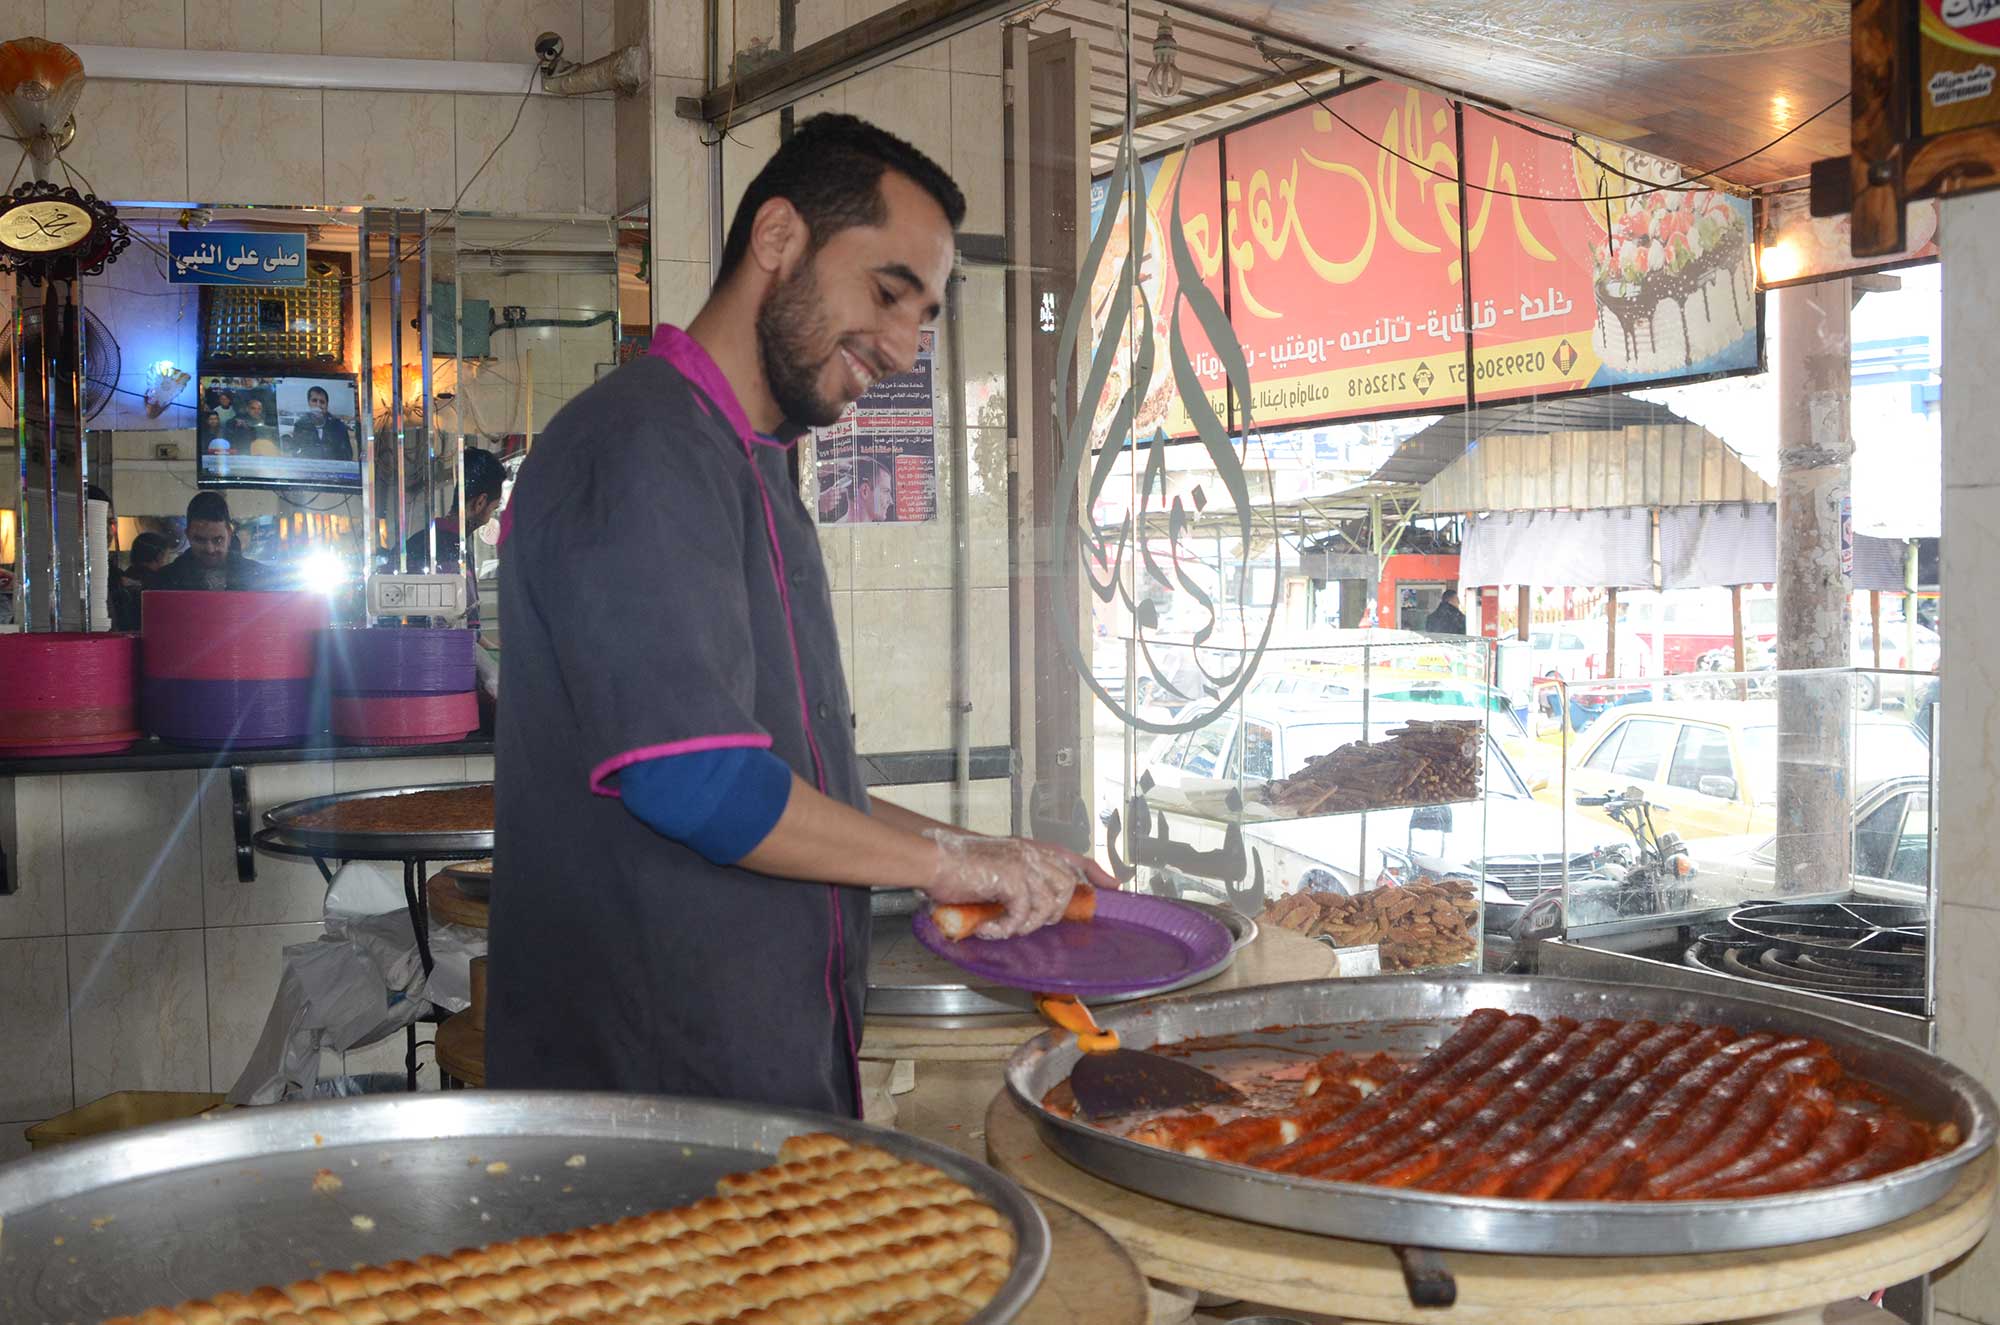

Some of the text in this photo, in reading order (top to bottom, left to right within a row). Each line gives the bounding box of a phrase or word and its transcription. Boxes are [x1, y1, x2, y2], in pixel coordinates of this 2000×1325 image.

[175, 242, 300, 274] صلى على النبي
